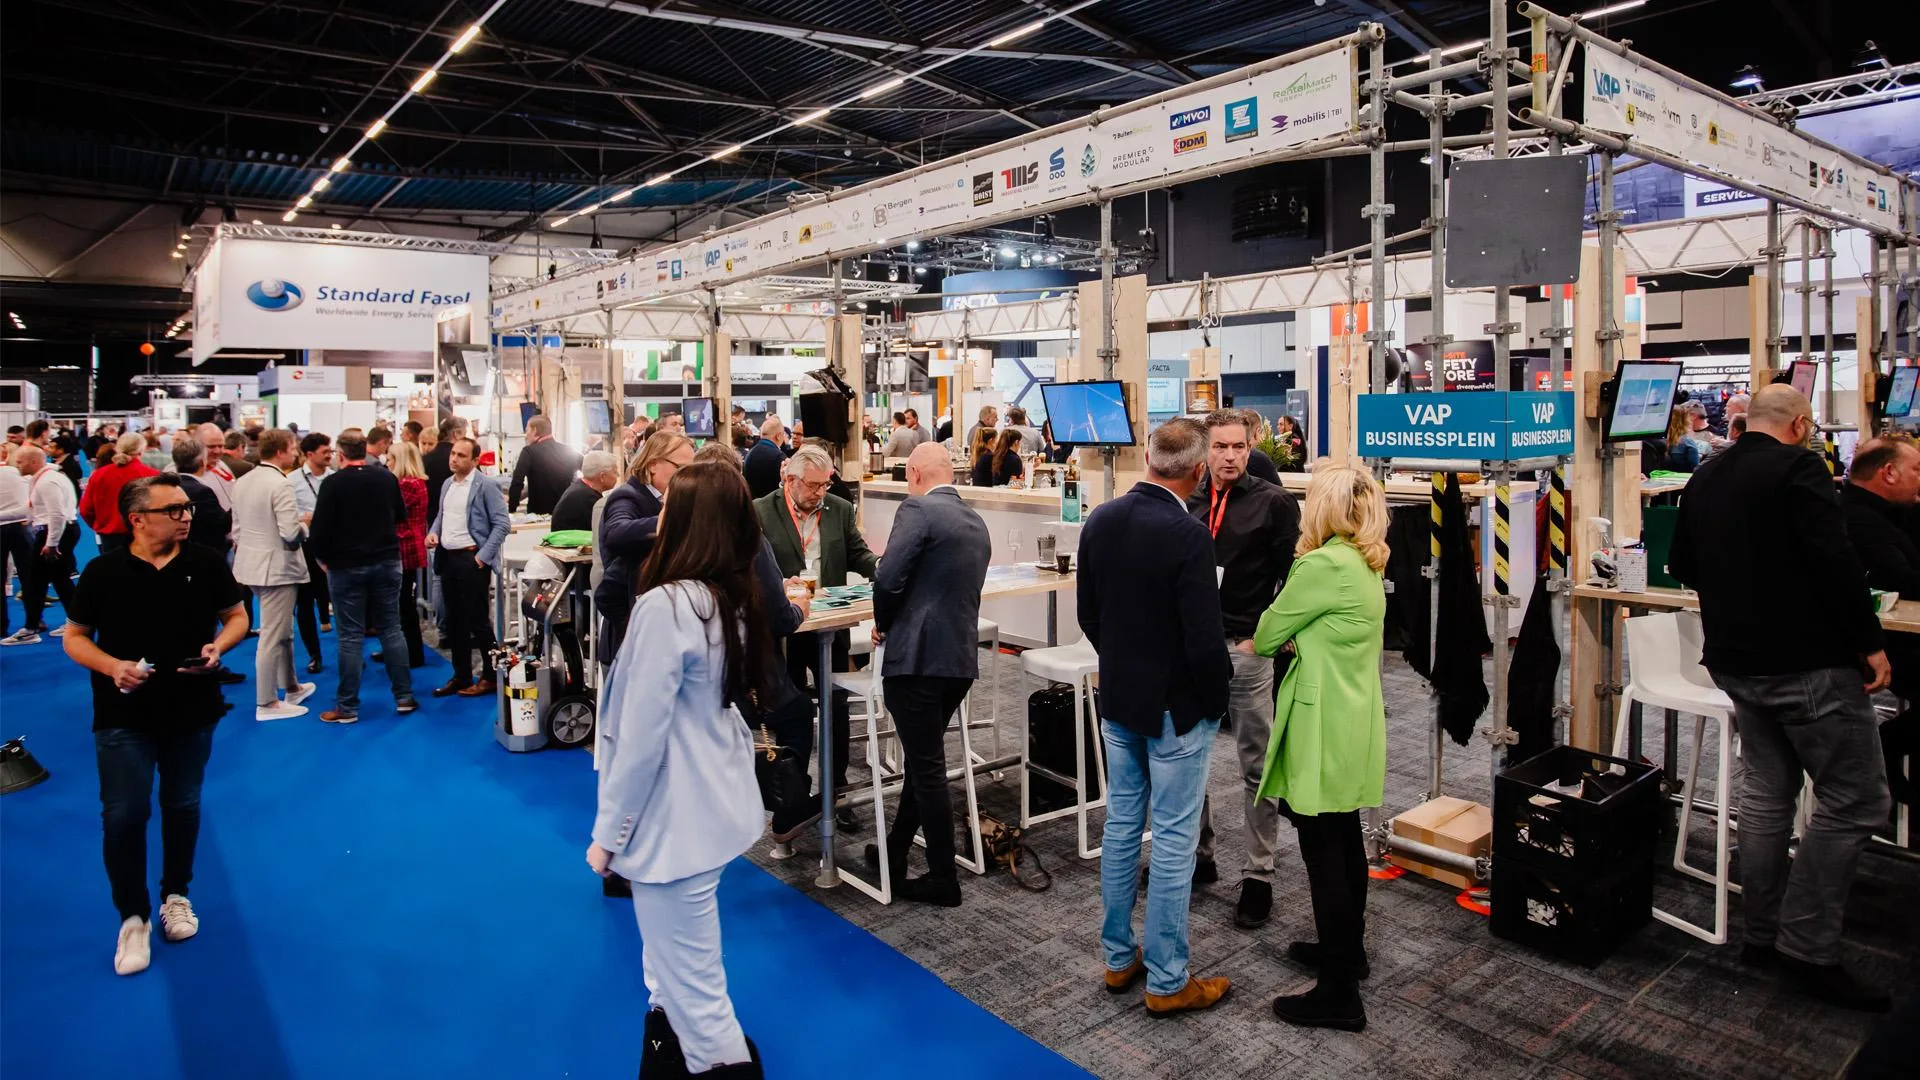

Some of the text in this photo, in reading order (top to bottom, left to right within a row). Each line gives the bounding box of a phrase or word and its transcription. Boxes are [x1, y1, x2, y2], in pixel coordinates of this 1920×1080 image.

[1593, 68, 1621, 101] VAP
[1183, 109, 1209, 124] MVOI
[1293, 110, 1326, 127] mobilis
[1180, 135, 1205, 150] DDM
[1112, 149, 1147, 163] PREMIER
[1112, 156, 1150, 170] MODULAR
[887, 198, 913, 210] Bergen
[704, 248, 721, 268] VAP
[316, 286, 471, 306] Standard Fasel
[315, 308, 434, 320] Worldwide Energy Servic
[1424, 357, 1477, 371] SFETY
[1684, 367, 1718, 375] REINIGEN
[1429, 369, 1476, 381] ORE
[1404, 404, 1452, 425] VAP
[1532, 402, 1555, 424] VAP
[1365, 431, 1496, 448] BUSINESSPLEIN
[1511, 428, 1572, 448] BUSINESSPLEIN
